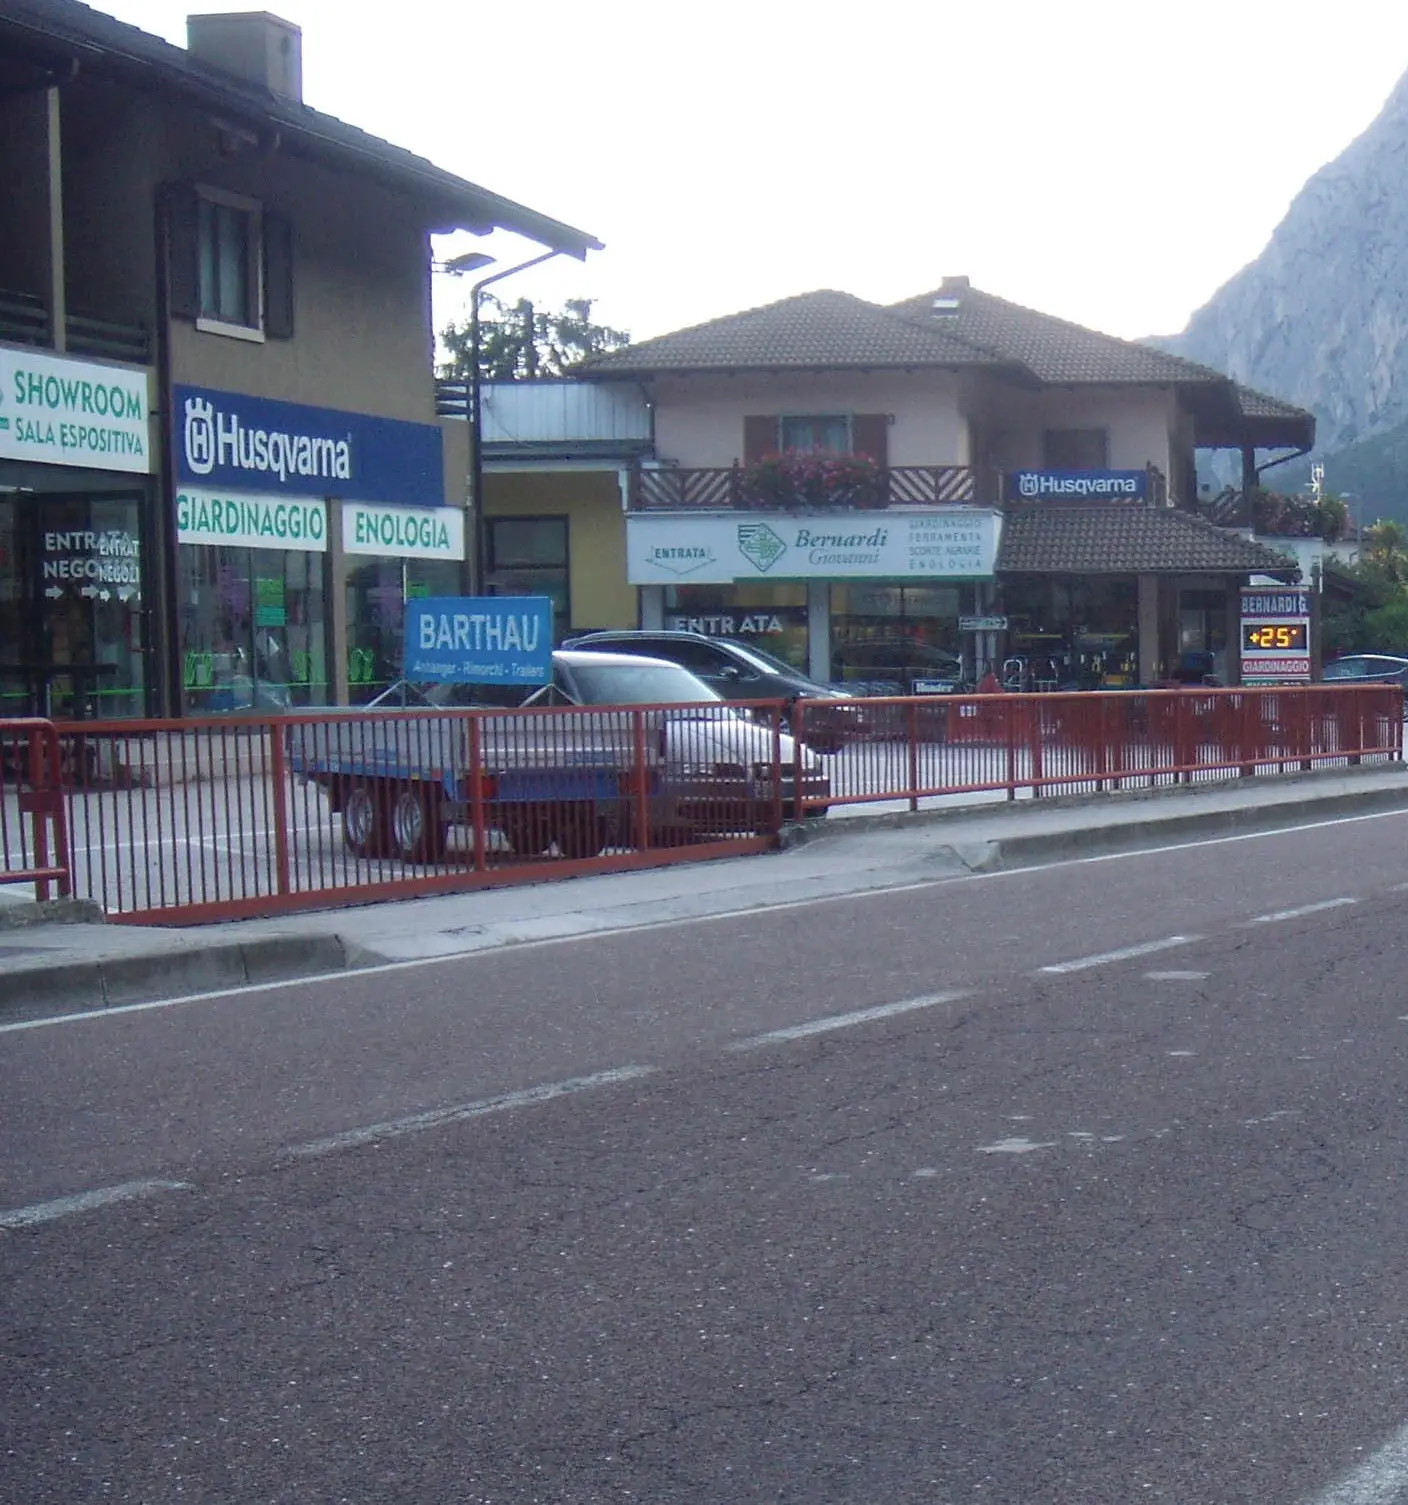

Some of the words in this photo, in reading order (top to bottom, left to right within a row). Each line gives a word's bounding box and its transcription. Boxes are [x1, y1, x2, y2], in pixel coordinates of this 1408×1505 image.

[14, 370, 142, 420] SHOWROOM
[15, 417, 55, 446] SALA
[60, 423, 143, 456] ESPOSITIVA
[216, 412, 349, 482] Husqvarna
[1041, 476, 1136, 494] Husqvarna
[177, 494, 323, 540] GIARDINAGGIO
[356, 511, 450, 549] ENOLOGIA
[795, 528, 888, 548] Bernardi
[908, 532, 982, 542] FERRAMENTA
[655, 547, 706, 559] ENTRATA
[808, 548, 880, 566] Giovanni
[909, 559, 981, 569] ENOLOGIA
[1242, 596, 1297, 613] BERNARDI
[419, 613, 539, 652] BARTHAU
[1242, 660, 1309, 673] GIARDINAGGIO
